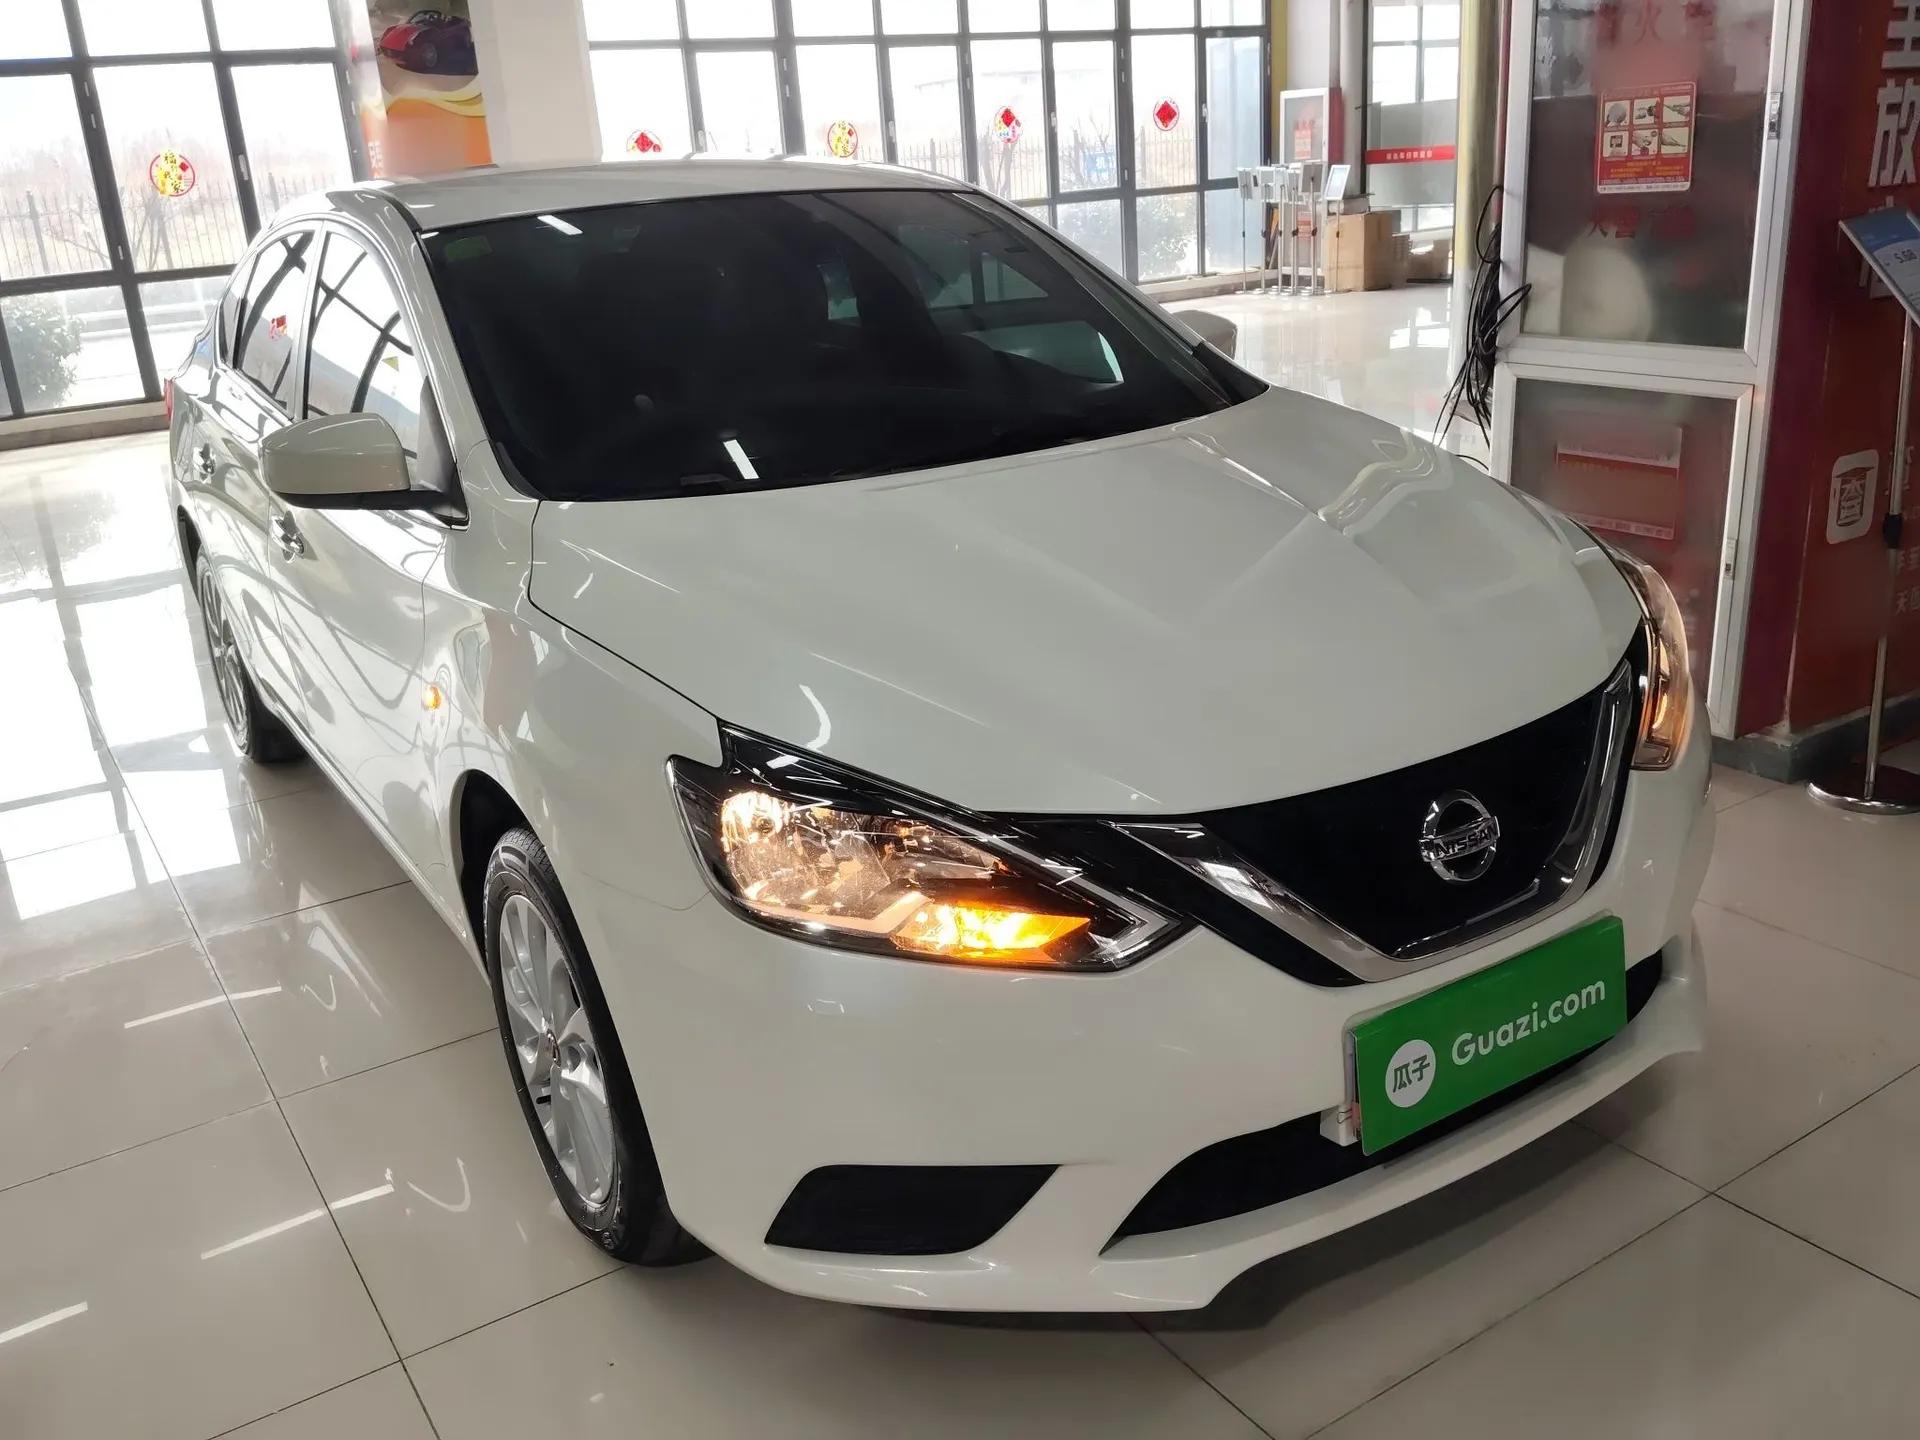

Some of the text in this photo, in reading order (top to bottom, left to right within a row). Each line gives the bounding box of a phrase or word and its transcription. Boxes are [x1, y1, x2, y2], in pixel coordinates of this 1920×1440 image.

[1436, 822, 1498, 858] NISSAN
[1451, 980, 1605, 1065] Guazi.com
[1391, 1053, 1431, 1093] 瓜子
